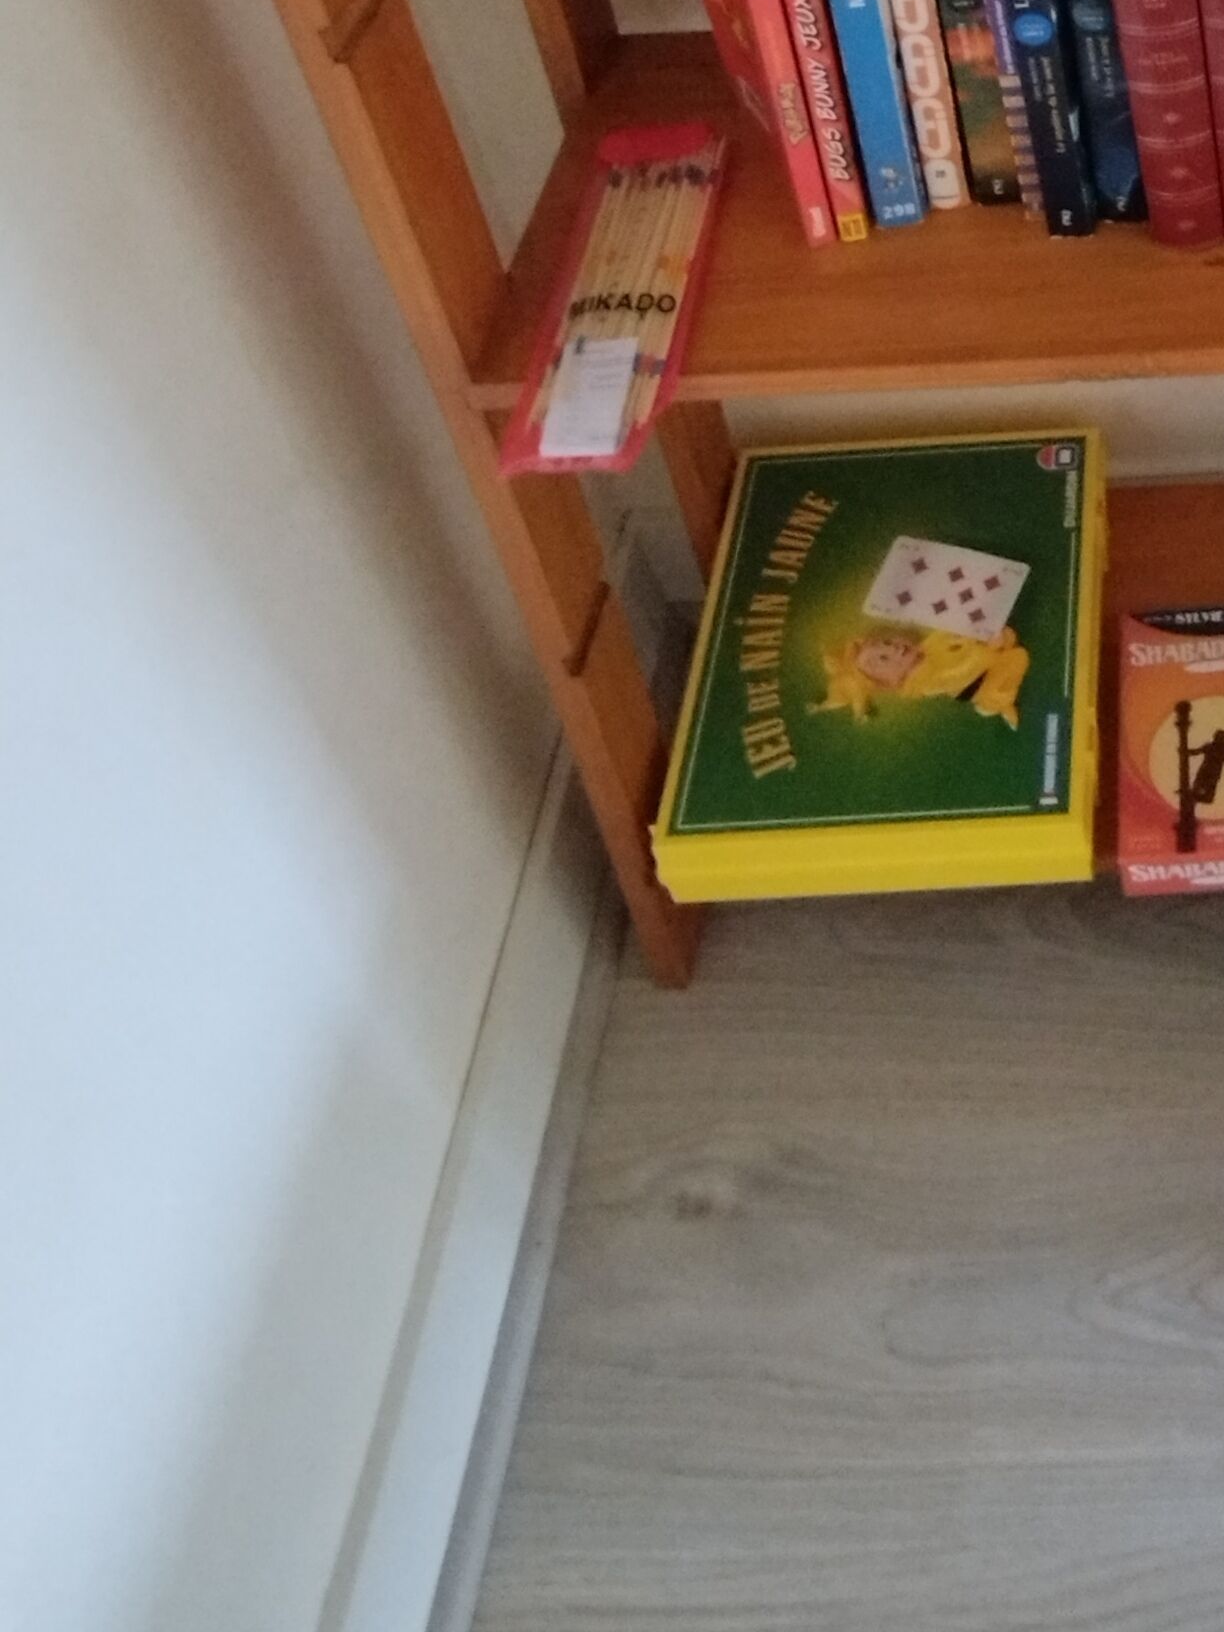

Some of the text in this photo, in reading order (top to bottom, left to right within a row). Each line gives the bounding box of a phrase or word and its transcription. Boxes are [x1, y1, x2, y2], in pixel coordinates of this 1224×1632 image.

[806, 57, 838, 122] BUNNY
[822, 125, 851, 183] BUGS
[568, 293, 677, 321] MIKADO
[761, 489, 840, 585] JAUNE
[747, 679, 781, 712] DE
[741, 716, 797, 780] JEU
